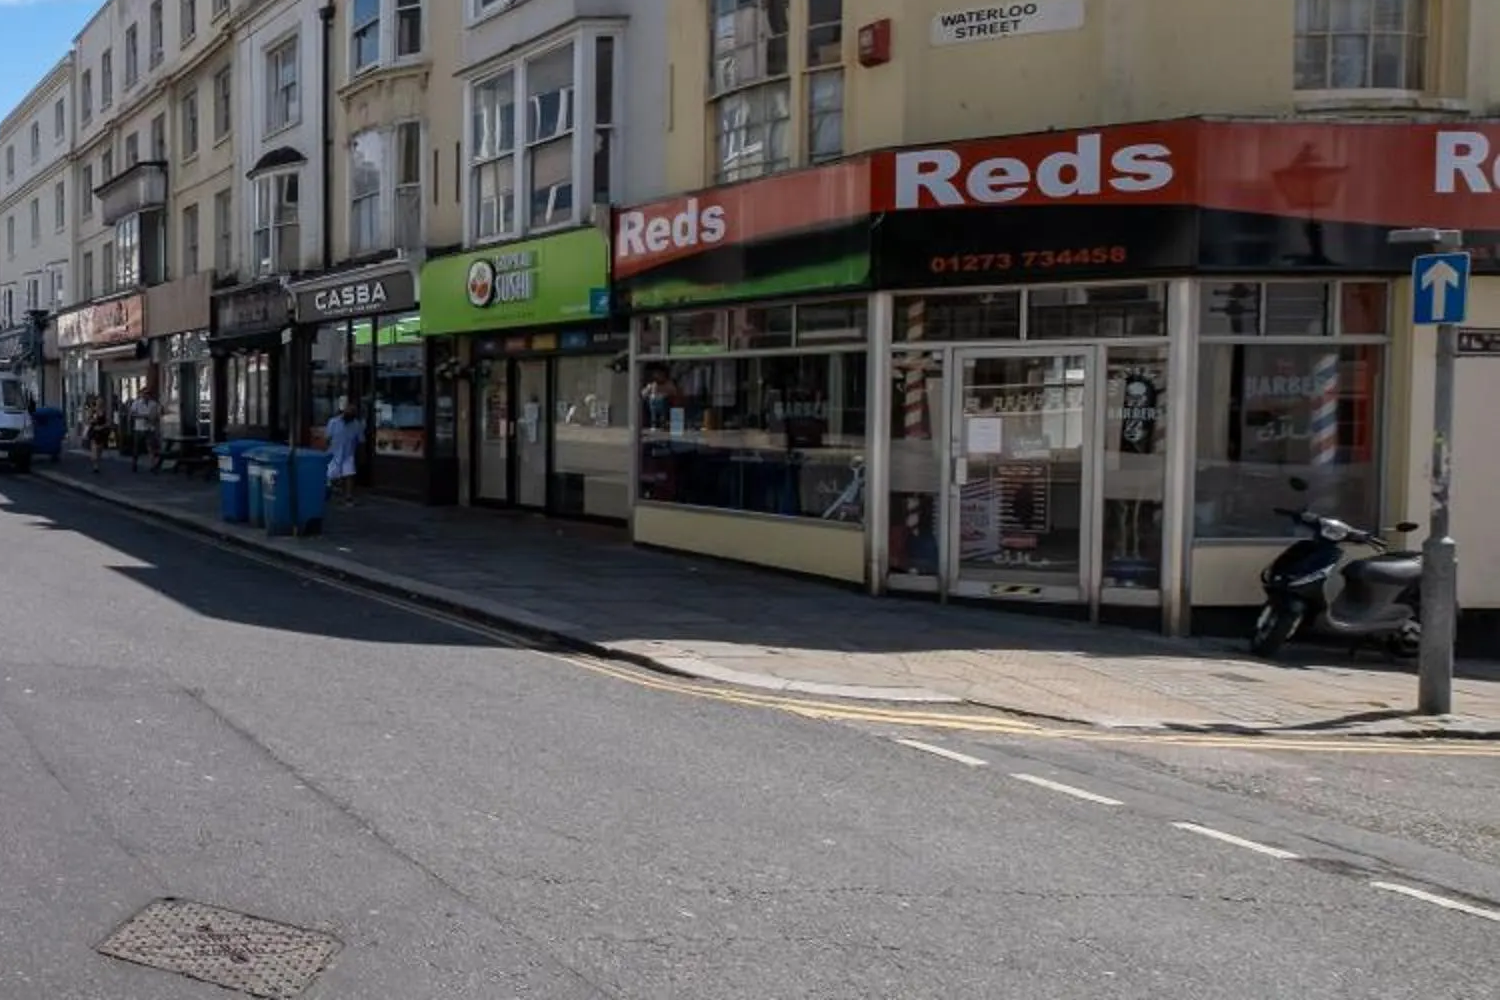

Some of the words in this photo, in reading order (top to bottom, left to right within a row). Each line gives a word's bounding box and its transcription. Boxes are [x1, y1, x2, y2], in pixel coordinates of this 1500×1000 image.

[941, 3, 1037, 26] WATERLOO
[955, 20, 1021, 38] STREET
[895, 134, 1174, 209] Reds
[1435, 131, 1500, 193] R
[617, 198, 726, 256] Reds
[931, 255, 1014, 273] 01273
[1022, 247, 1126, 268] 734458
[315, 282, 387, 310] CASBA
